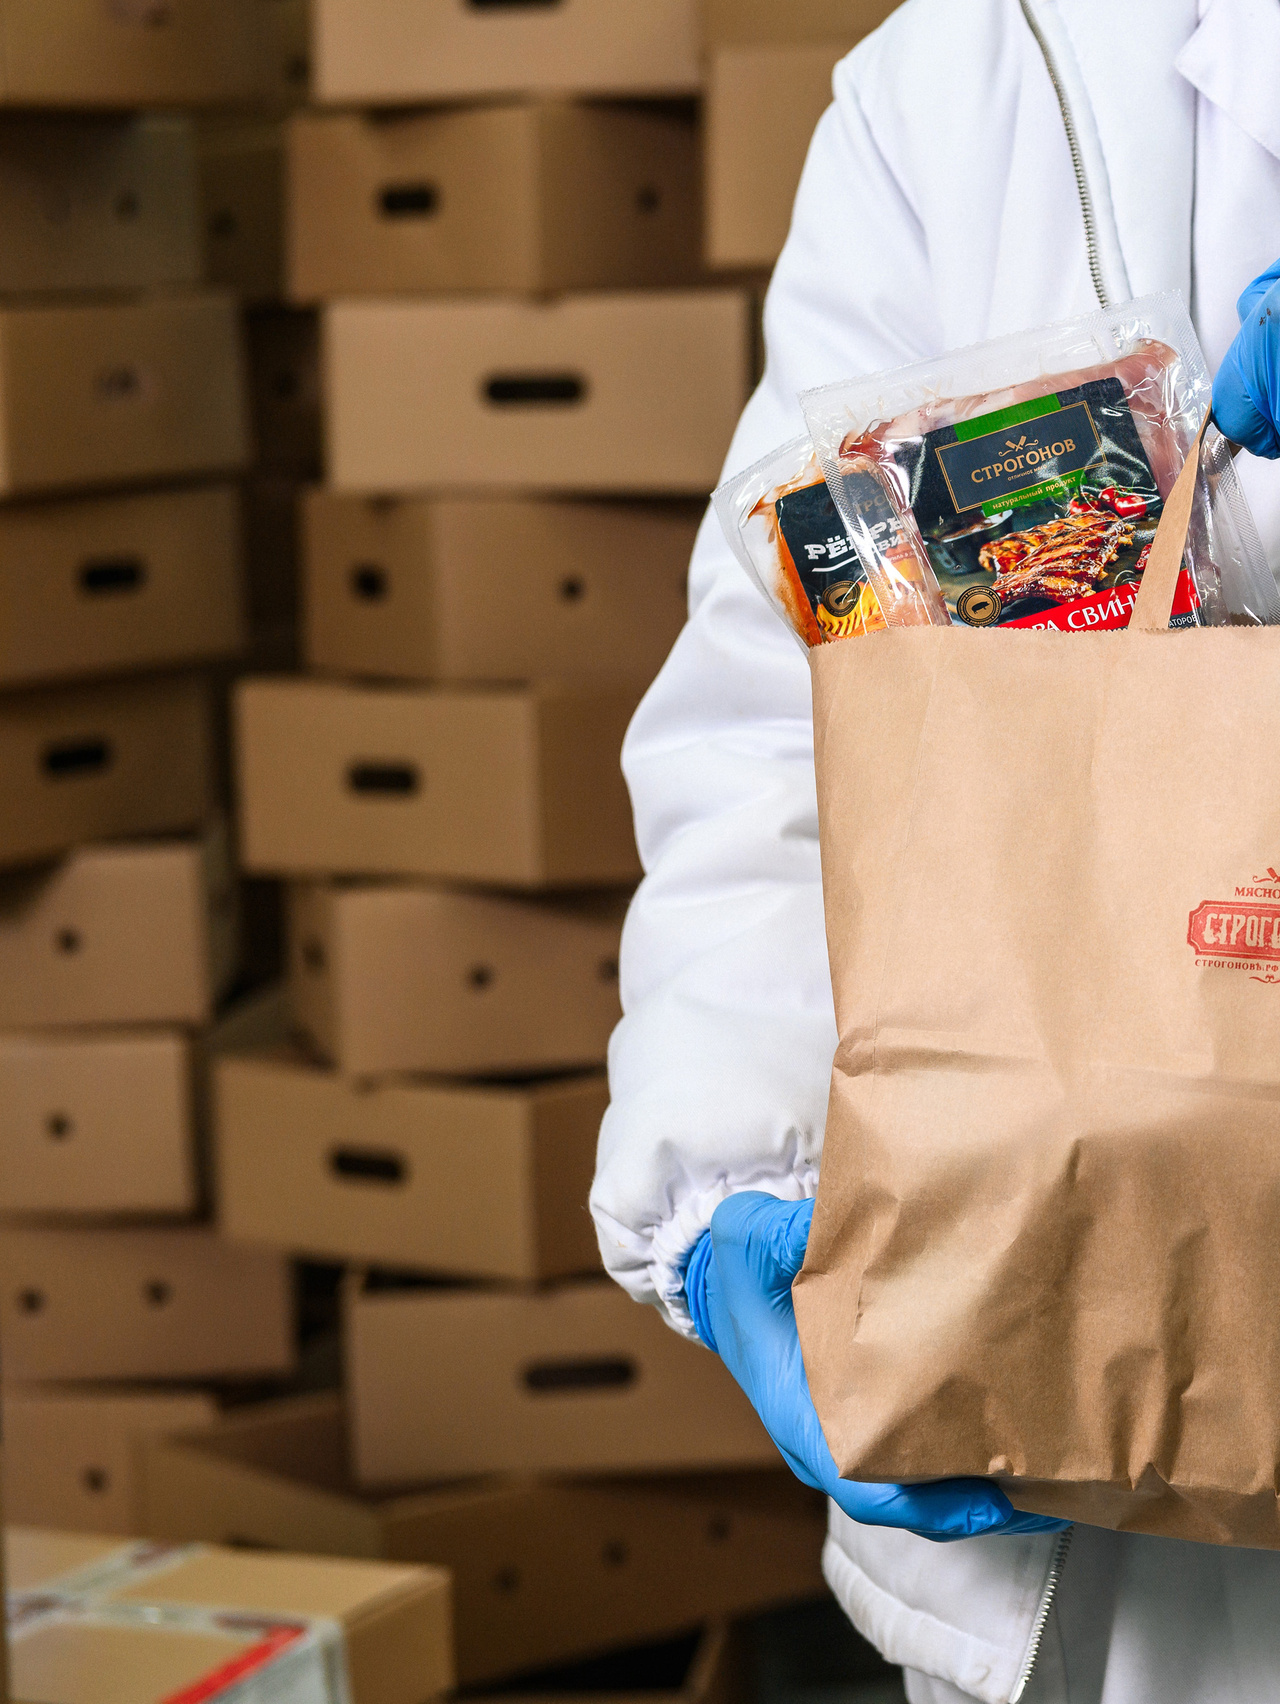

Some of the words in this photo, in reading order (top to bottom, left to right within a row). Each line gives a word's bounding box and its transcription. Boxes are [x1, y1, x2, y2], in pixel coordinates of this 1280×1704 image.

[971, 438, 1076, 483] СТРОГОНОВ
[992, 487, 1043, 509] натуральный
[1045, 476, 1077, 492] продукт
[1067, 592, 1138, 629] СВИН
